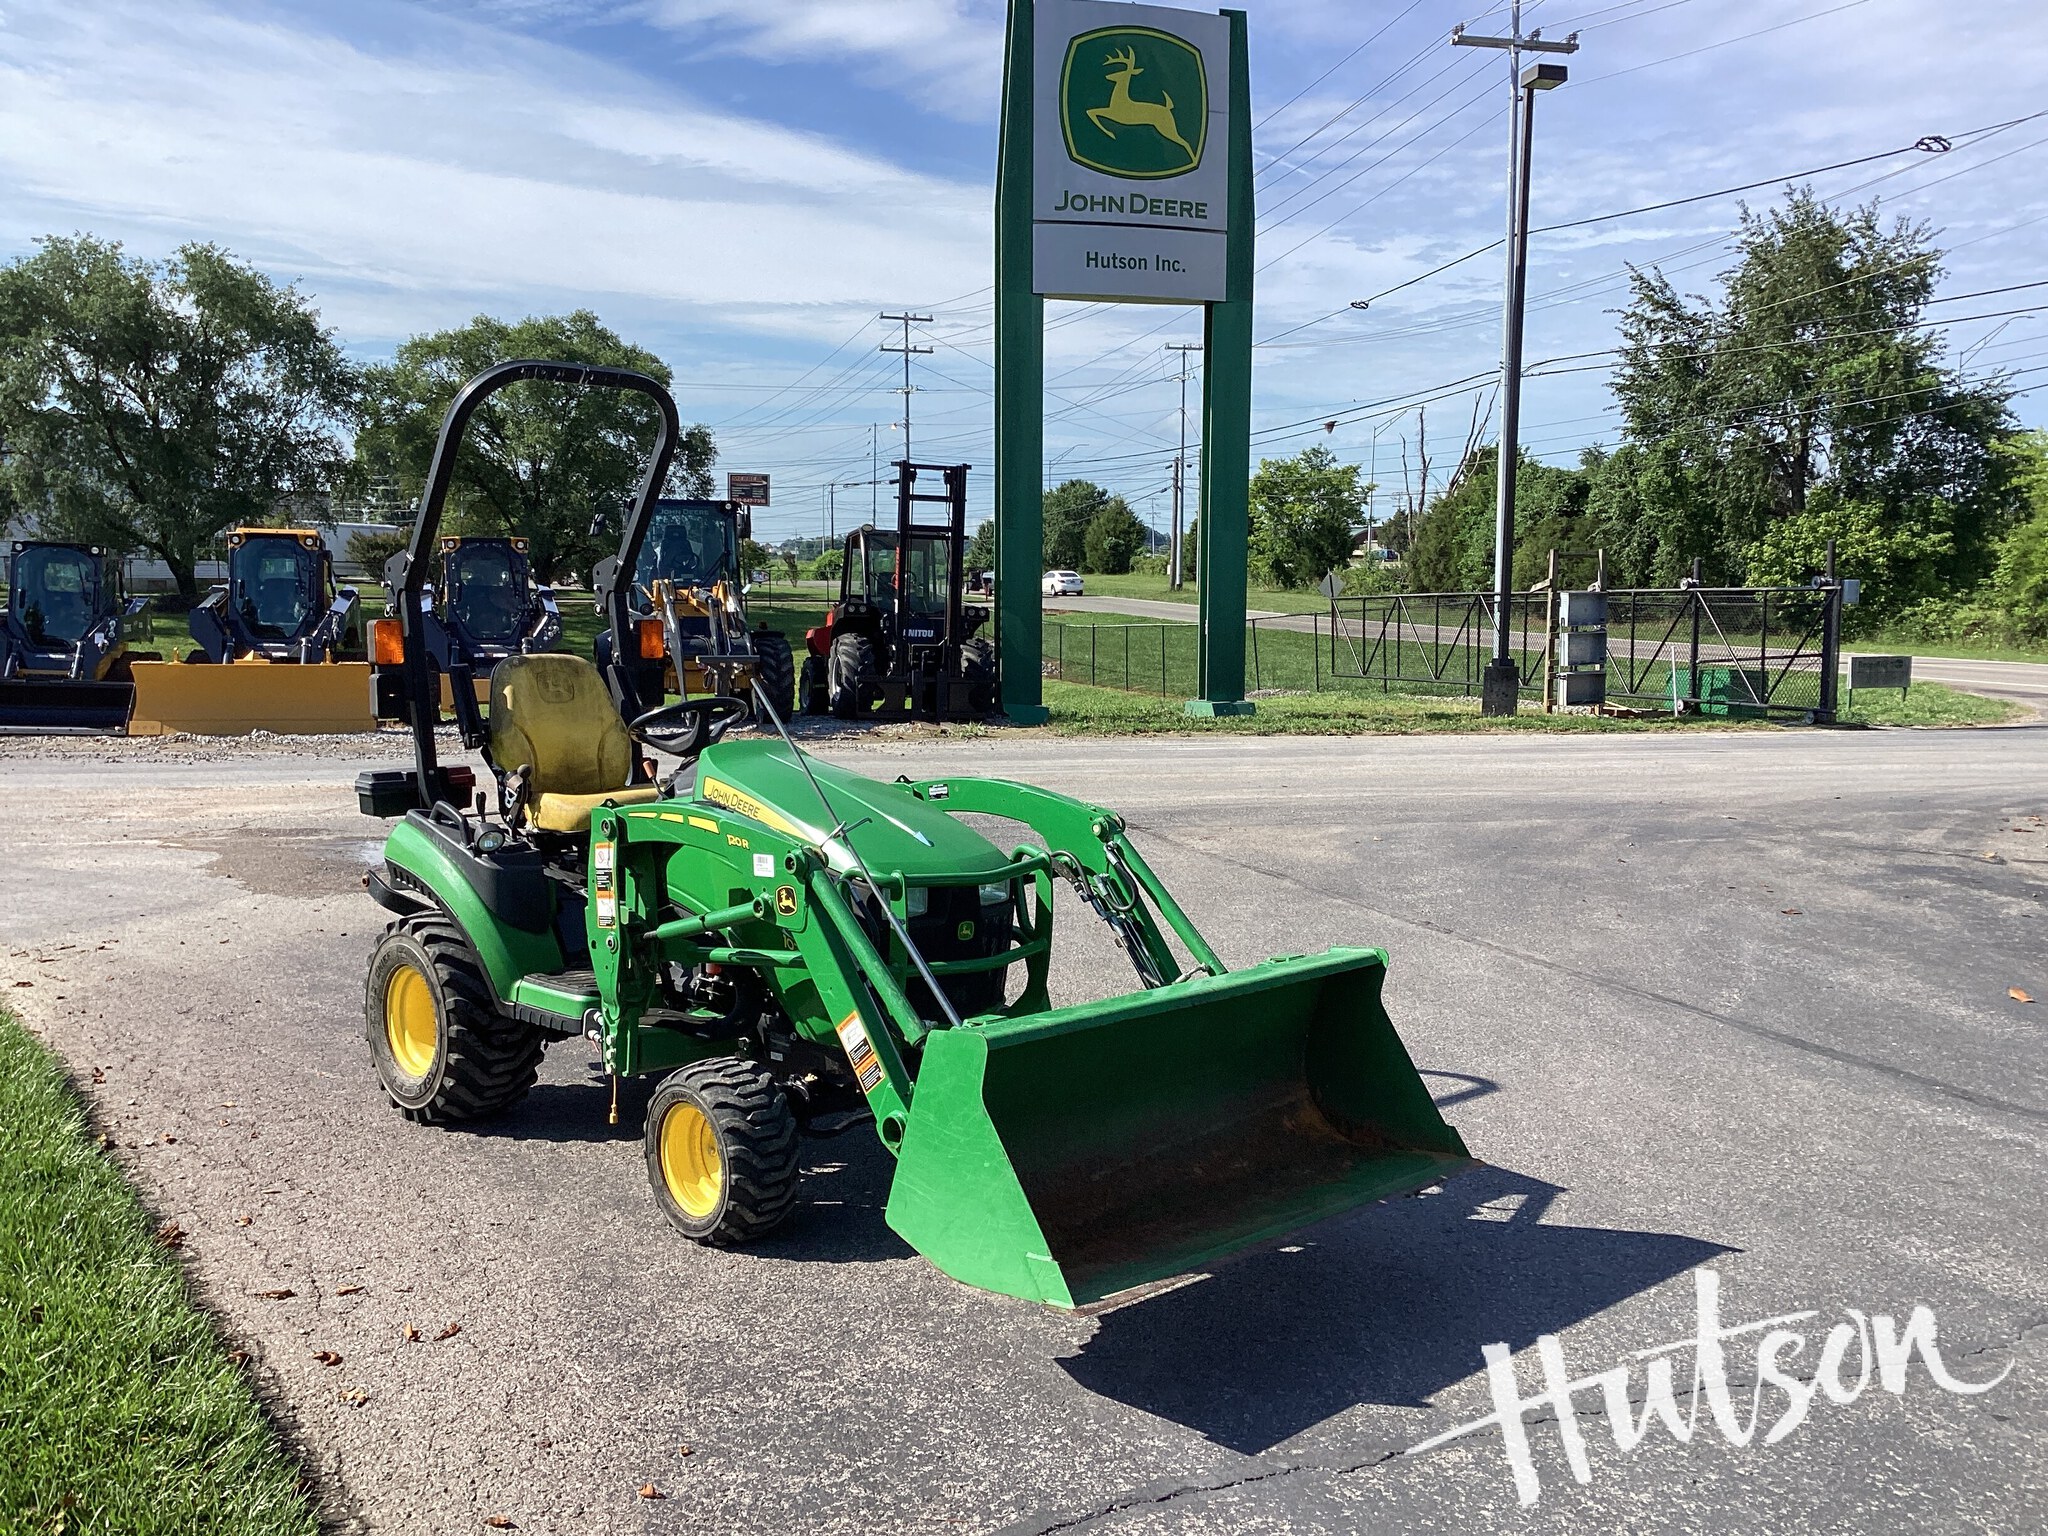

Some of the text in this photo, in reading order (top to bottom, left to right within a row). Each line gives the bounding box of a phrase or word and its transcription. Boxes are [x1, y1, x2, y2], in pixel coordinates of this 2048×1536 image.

[1054, 190, 1208, 220] JOHN DEERE
[1086, 251, 1186, 273] Hutson Inc.
[902, 629, 934, 638] NITOU
[708, 784, 760, 818] JOHN DEERE
